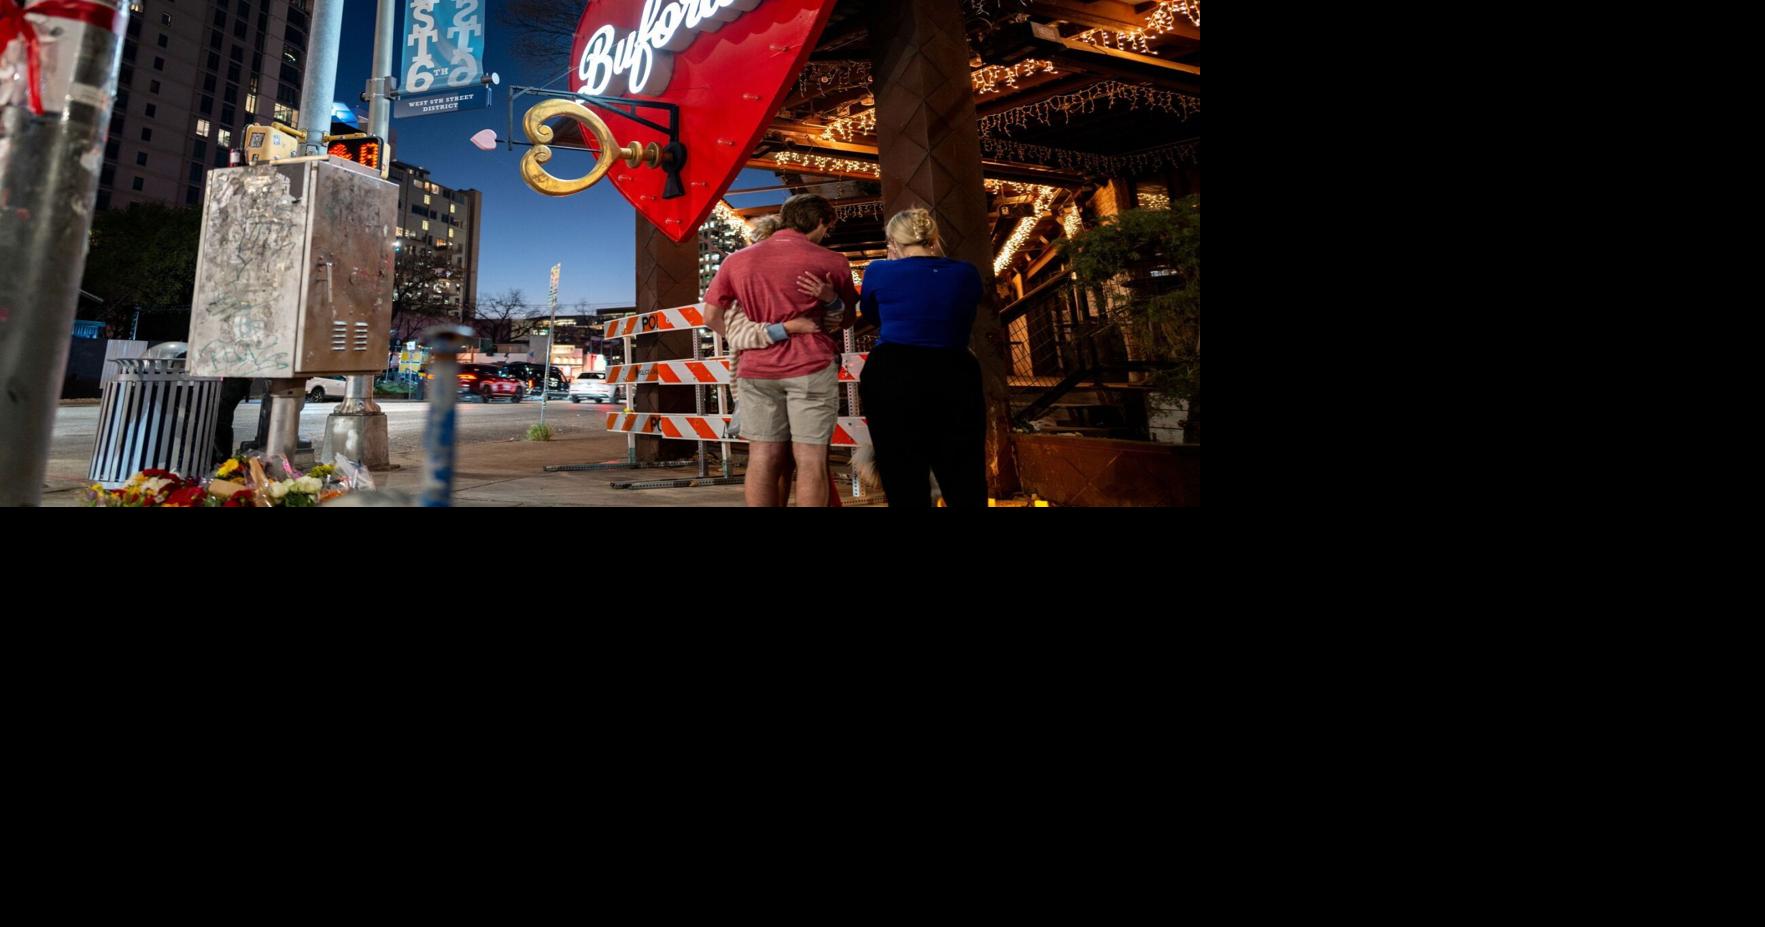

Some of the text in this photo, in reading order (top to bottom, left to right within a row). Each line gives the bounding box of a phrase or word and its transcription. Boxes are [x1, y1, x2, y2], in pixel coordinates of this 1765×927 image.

[576, 0, 735, 103] Bufor
[446, 94, 474, 103] STREET
[423, 102, 459, 112] DISTRICT
